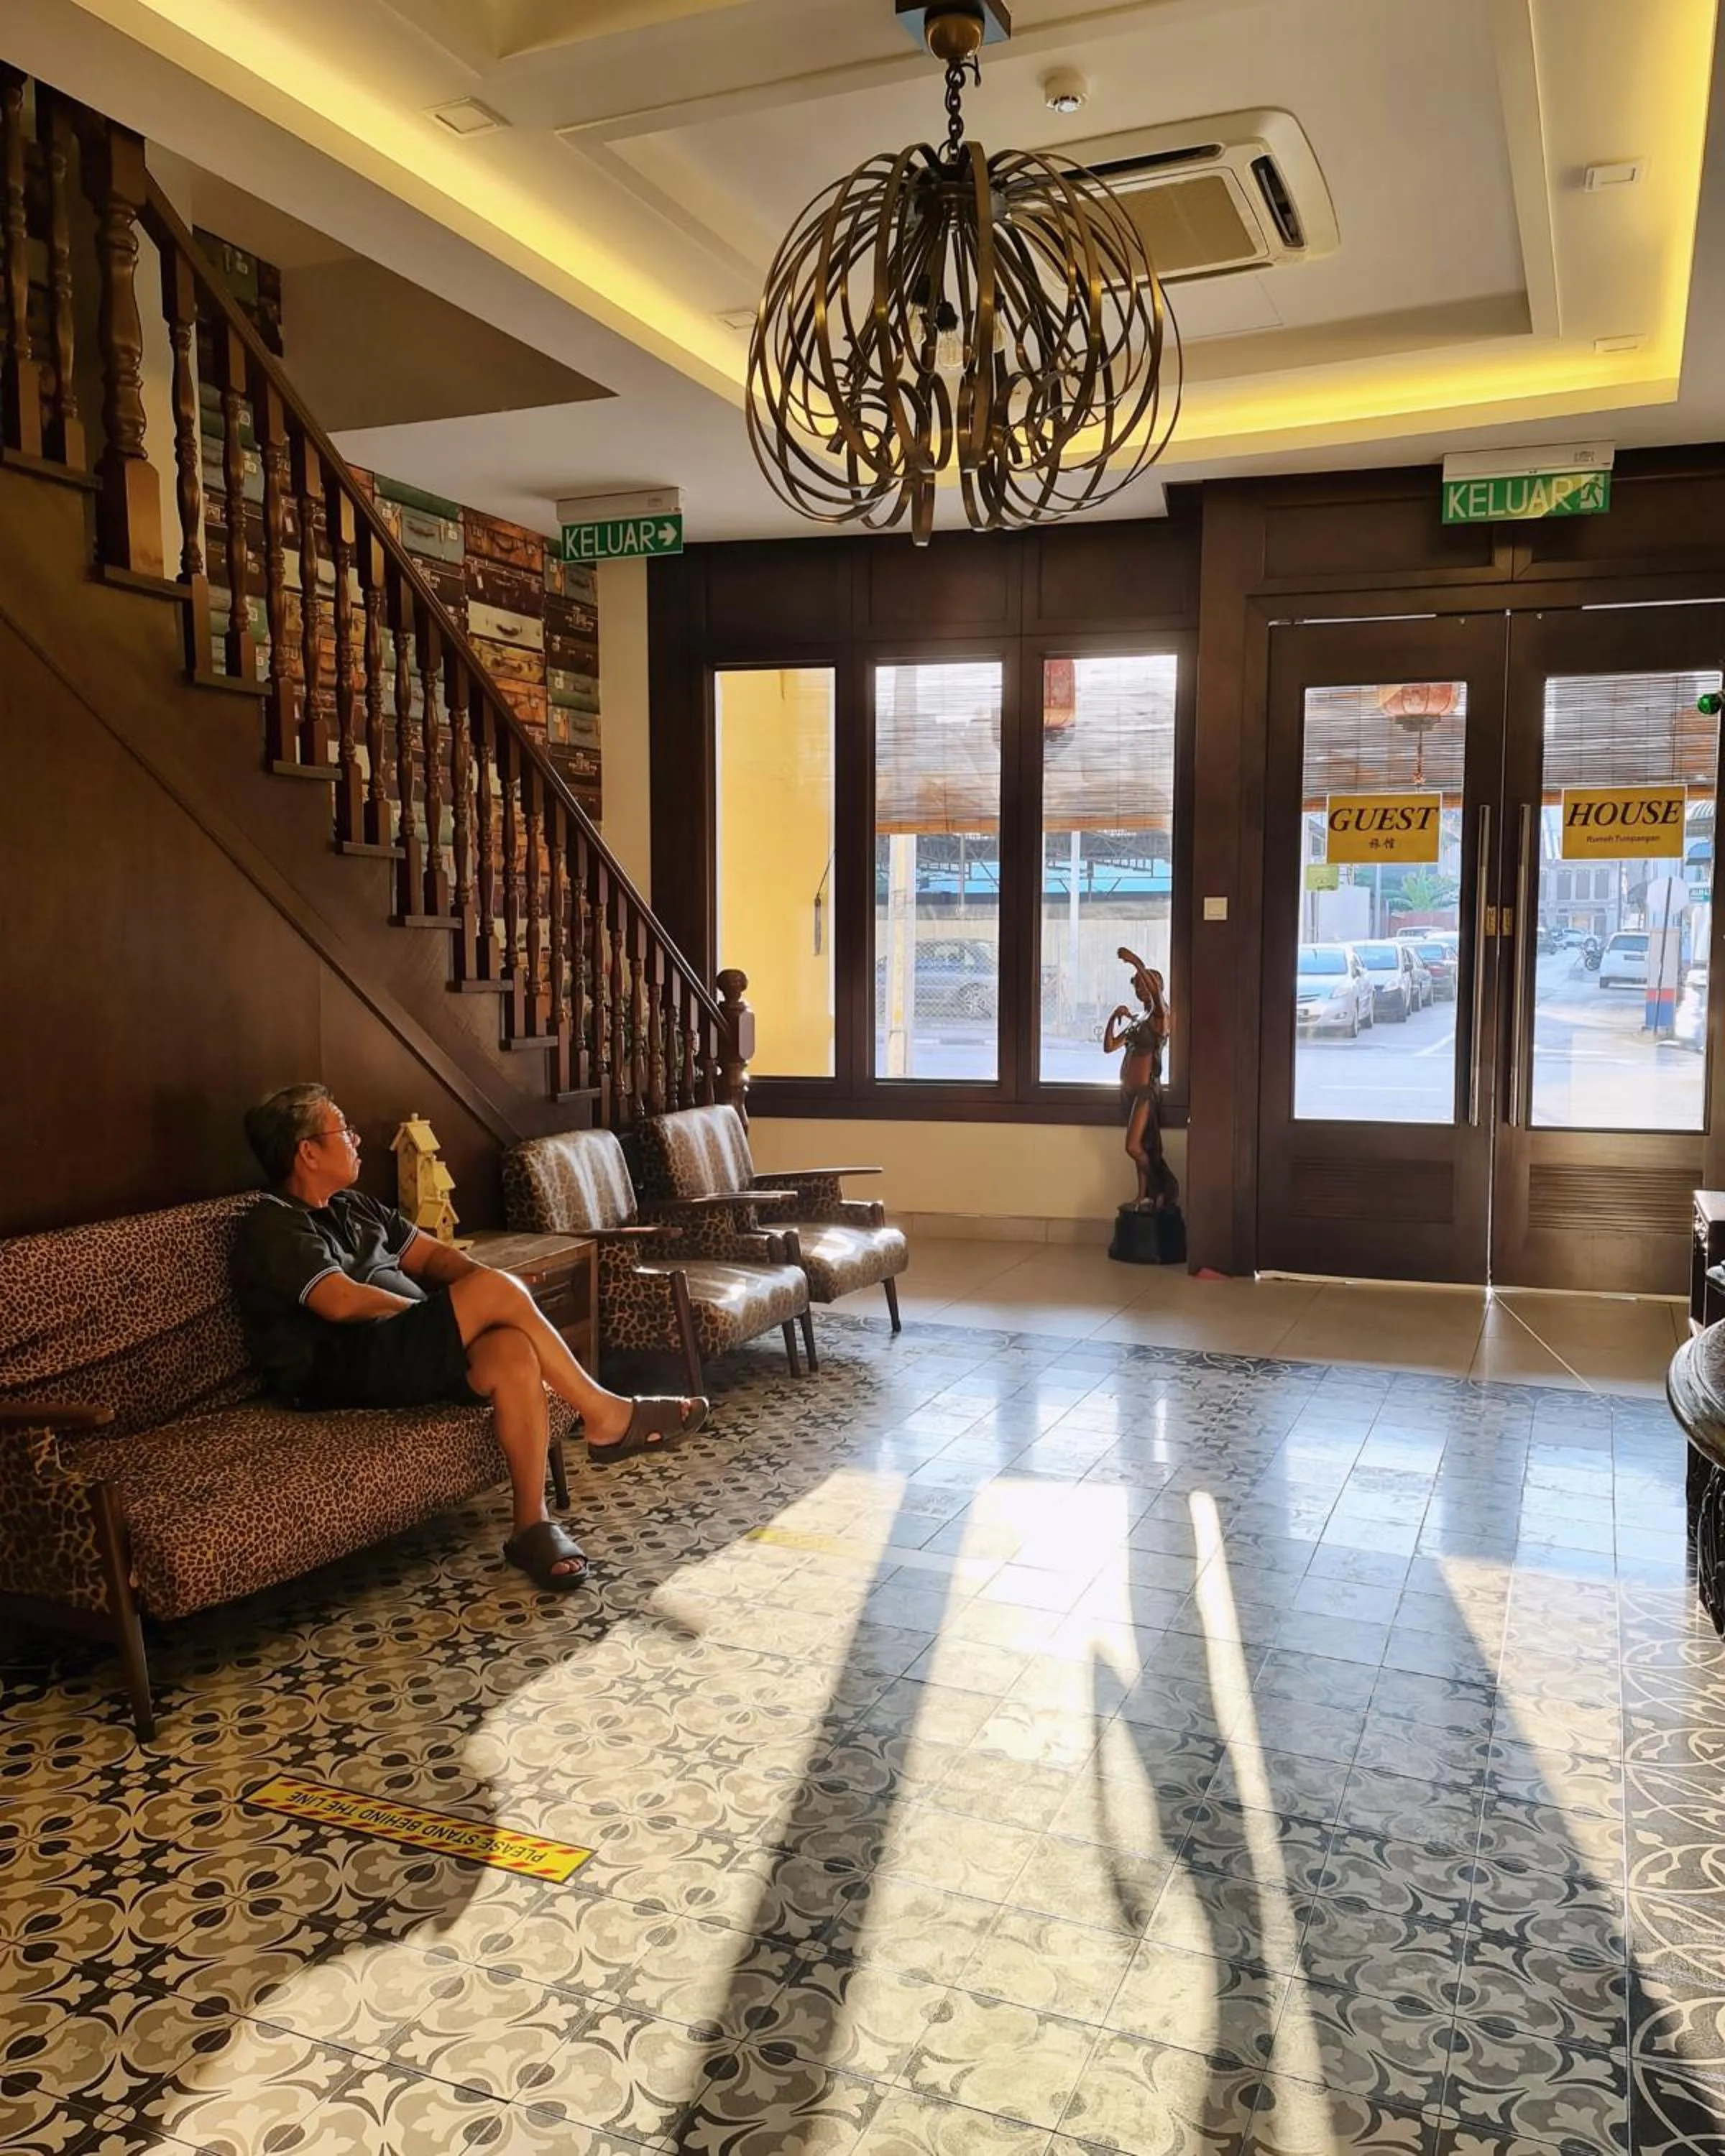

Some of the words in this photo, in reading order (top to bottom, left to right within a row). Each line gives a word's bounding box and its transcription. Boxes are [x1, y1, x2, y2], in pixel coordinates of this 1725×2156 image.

[1448, 478, 1572, 518] KELUAR
[566, 521, 655, 558] KELUAR
[1330, 807, 1438, 831] GUEST
[1566, 800, 1683, 826] HOUSE
[286, 1792, 328, 1807] LINE
[323, 1800, 359, 1816] THE
[359, 1809, 423, 1831] BEHIND
[423, 1825, 480, 1845] STAND
[477, 1838, 548, 1863] PLEASE
